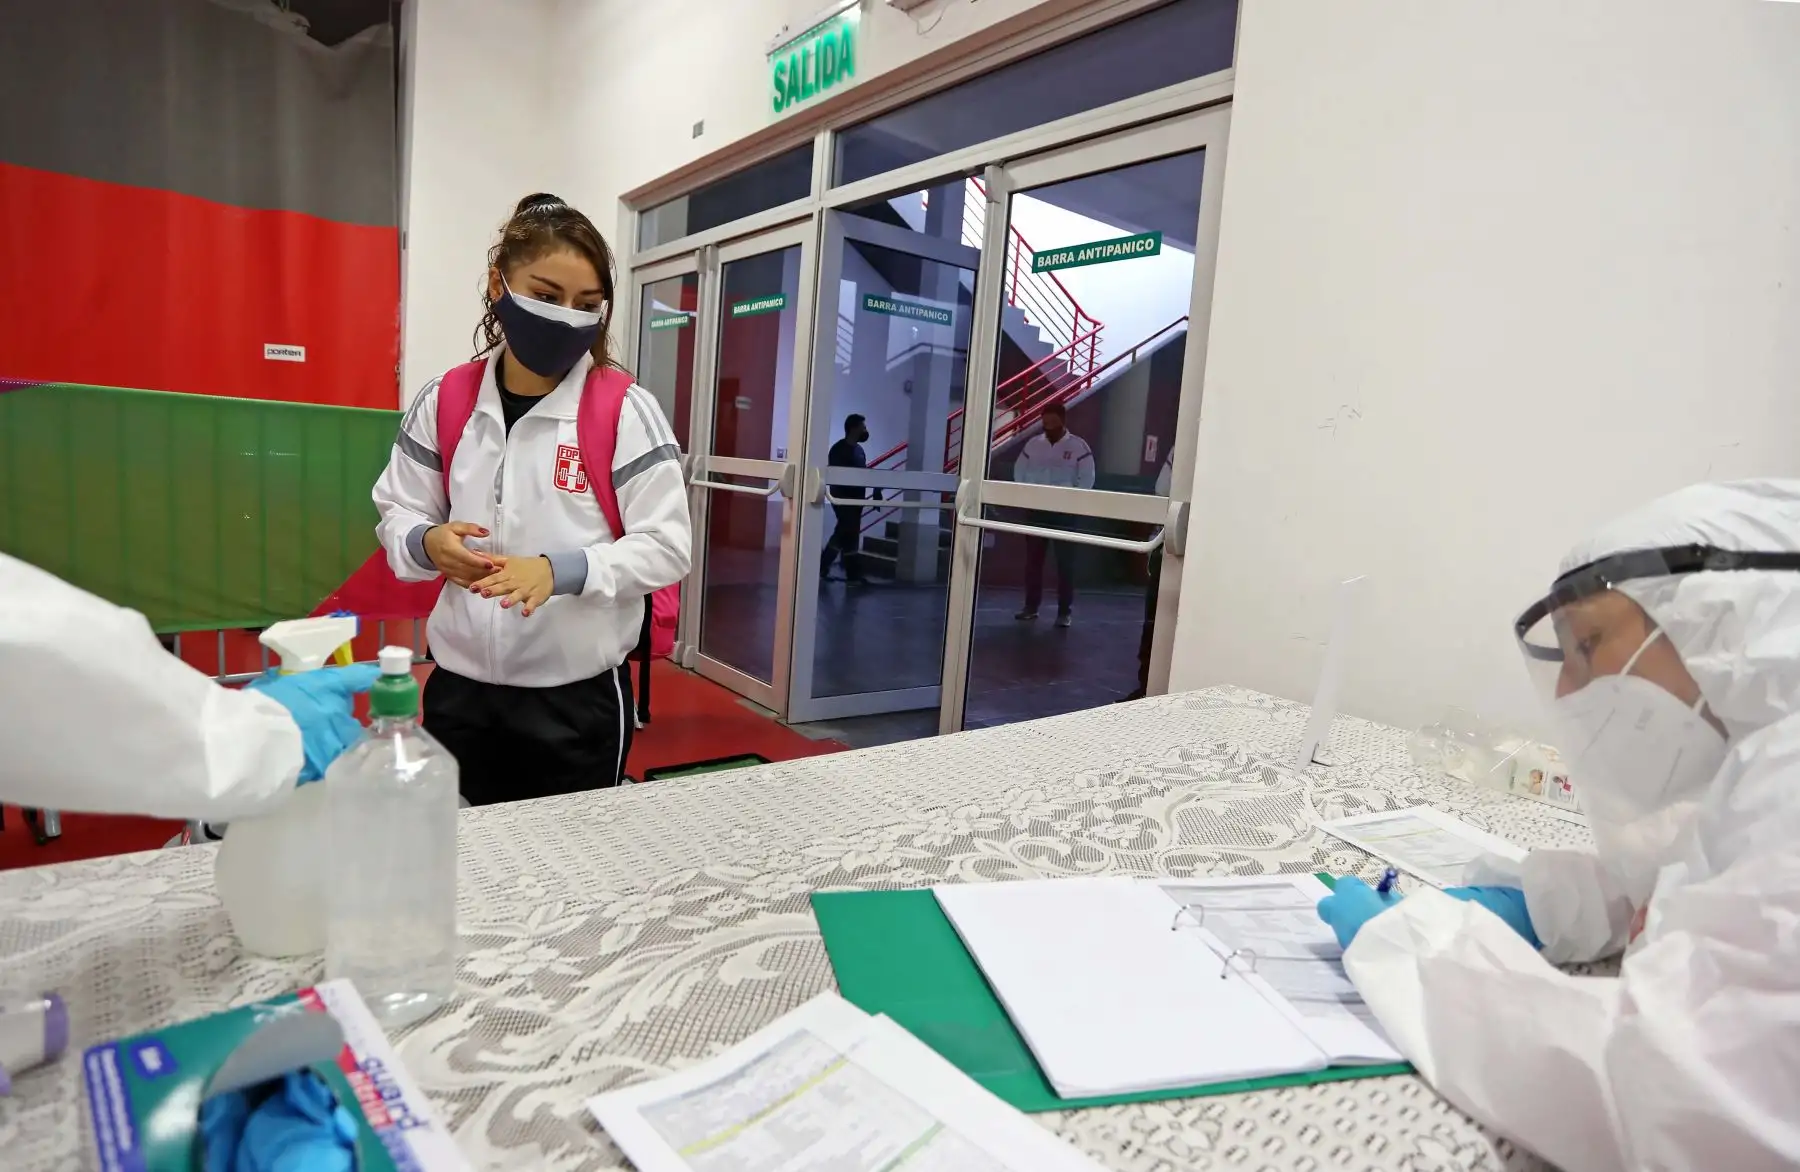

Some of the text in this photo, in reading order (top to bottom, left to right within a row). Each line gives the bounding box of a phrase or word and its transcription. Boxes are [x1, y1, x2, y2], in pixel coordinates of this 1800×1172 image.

[773, 23, 855, 113] SALIDA
[1037, 238, 1155, 268] BARRA ANTIPANICO
[733, 297, 783, 315] BARRA ANTIPANICO
[866, 298, 949, 322] BARRA ANTIPANICO
[560, 447, 582, 460] FDP
